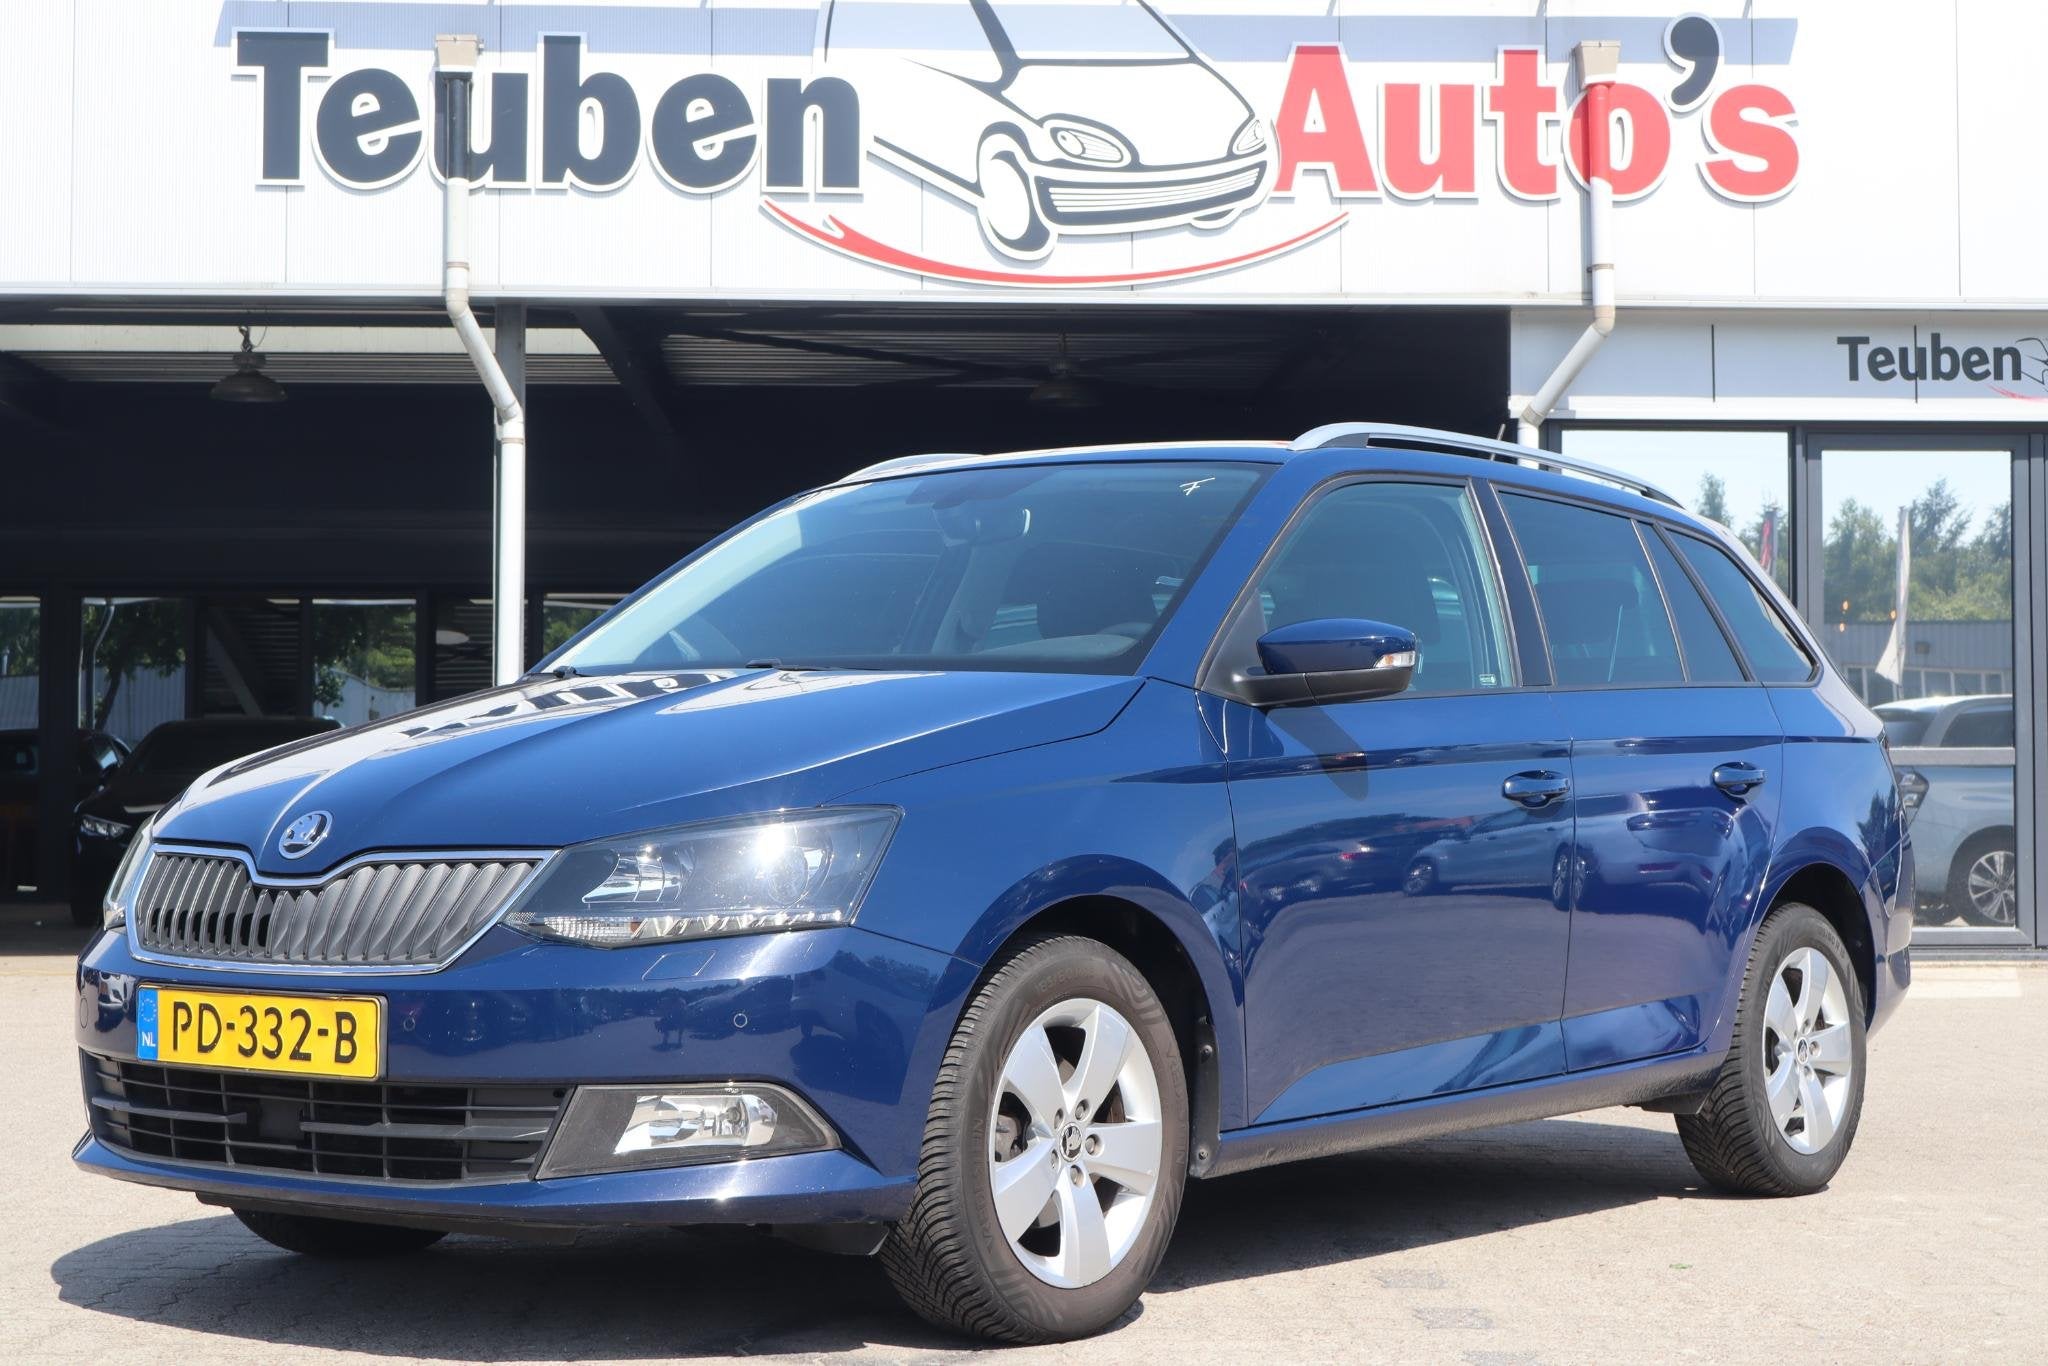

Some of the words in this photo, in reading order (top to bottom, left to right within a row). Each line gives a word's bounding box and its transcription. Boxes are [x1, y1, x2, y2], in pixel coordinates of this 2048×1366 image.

[236, 31, 860, 188] Teuben
[1273, 16, 1799, 195] Auto's
[1837, 332, 2022, 382] Teuben
[141, 1033, 156, 1048] NL
[172, 1001, 358, 1064] PD-332-B
